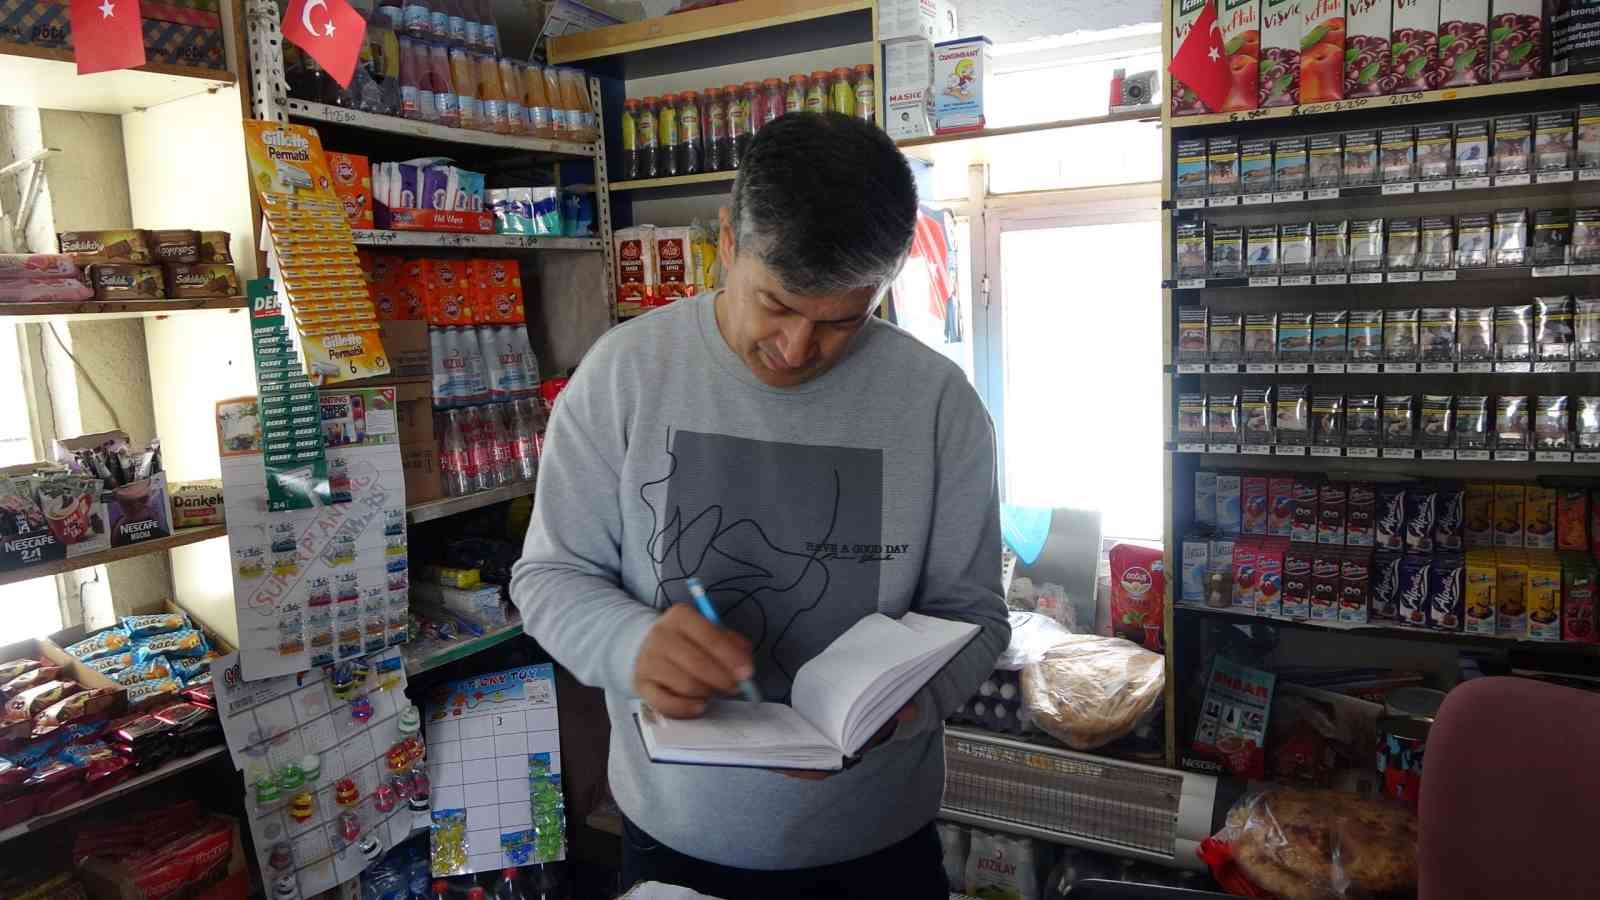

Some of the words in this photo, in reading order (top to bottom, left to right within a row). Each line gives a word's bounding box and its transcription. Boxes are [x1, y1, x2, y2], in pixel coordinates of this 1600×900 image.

[267, 146, 311, 162] Permatik
[349, 360, 358, 375] 6
[841, 543, 850, 553] A
[852, 543, 882, 554] GOOD
[885, 543, 909, 554] DAY
